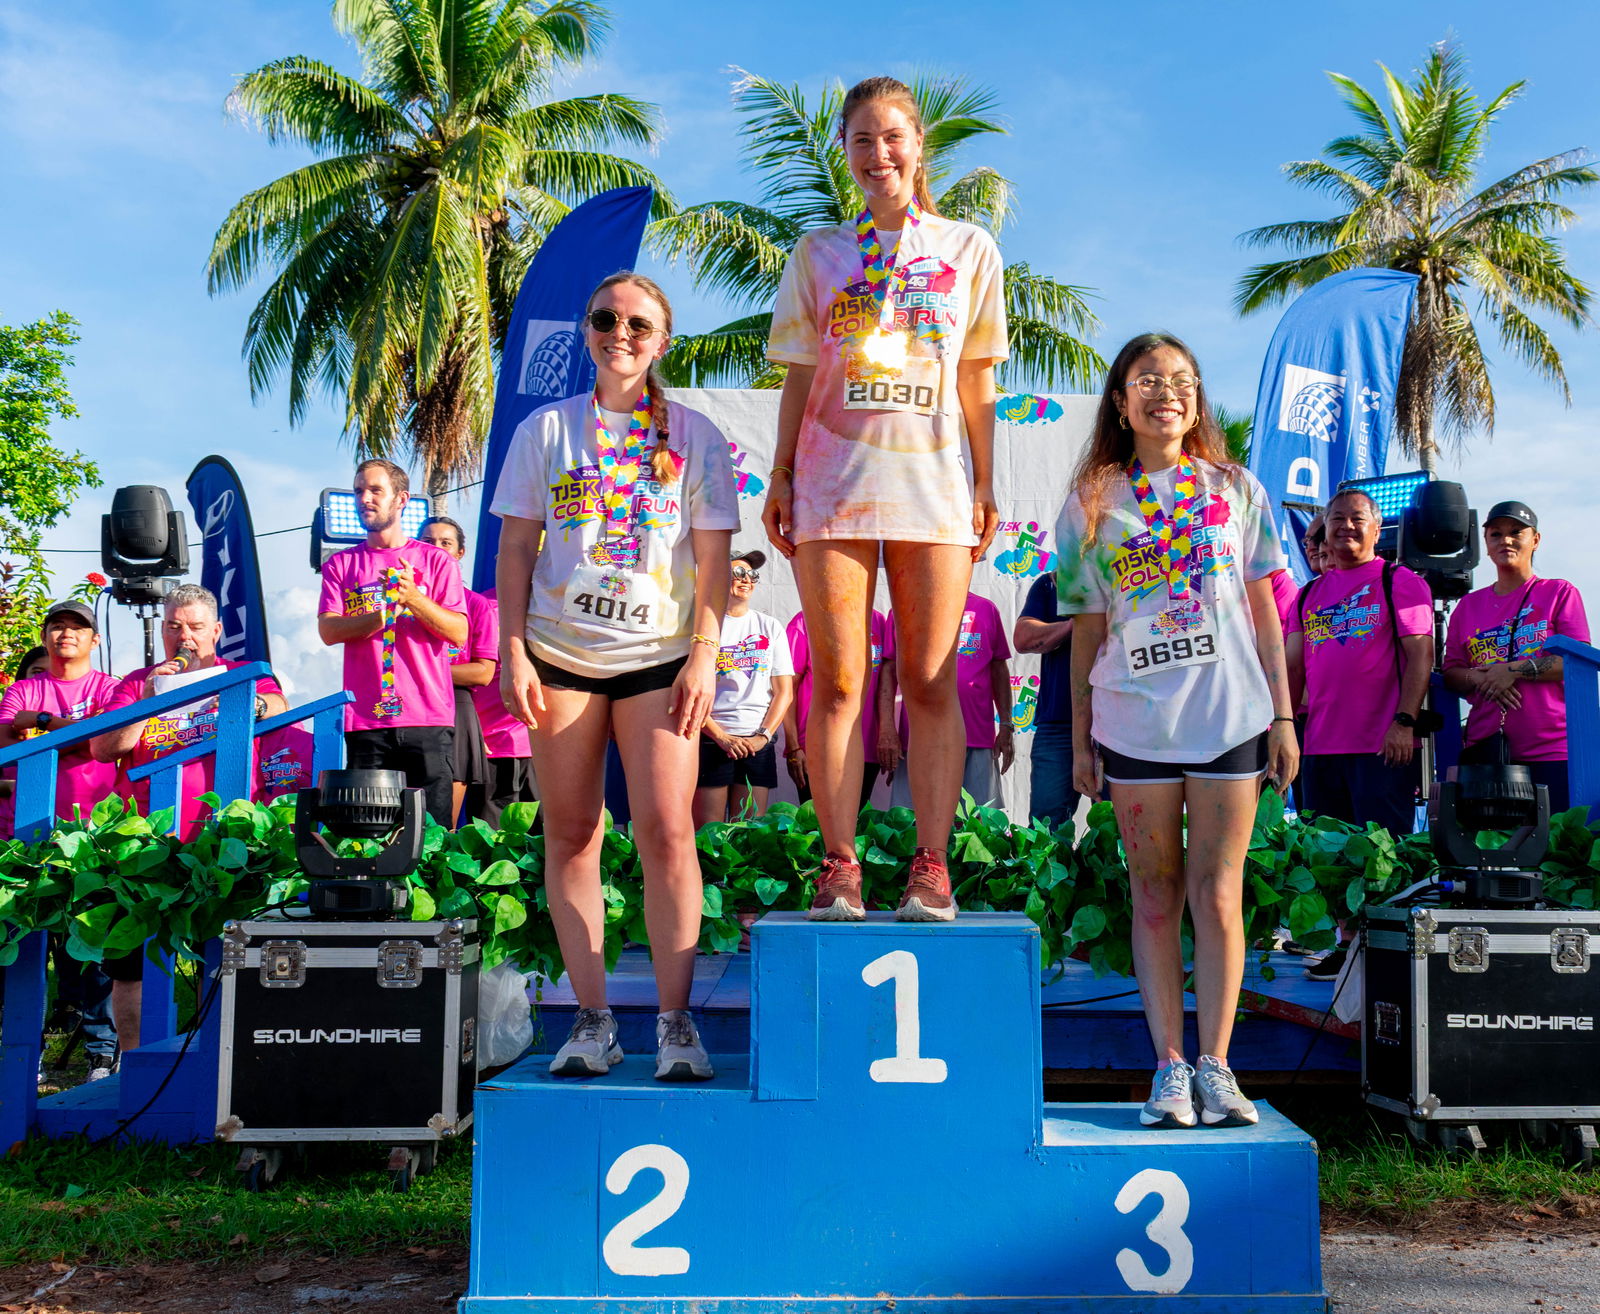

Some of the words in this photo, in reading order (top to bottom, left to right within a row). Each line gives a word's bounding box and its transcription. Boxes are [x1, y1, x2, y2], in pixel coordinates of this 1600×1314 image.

[858, 285, 870, 293] 20
[895, 292, 959, 308] UBBLE
[830, 309, 909, 338] COLR
[914, 309, 957, 327] RUN
[848, 381, 933, 408] 2030
[1354, 421, 1371, 480] EMBER
[582, 469, 600, 477] 202
[551, 479, 601, 502] TJ5K
[553, 499, 609, 520] COLO
[636, 497, 680, 515] RUN
[1136, 535, 1153, 545] 202
[1111, 546, 1158, 577] TJ5K
[1197, 541, 1237, 563] RUN
[345, 592, 374, 610] TJ5K
[349, 603, 383, 616] COLO
[573, 592, 650, 625] 4014
[1305, 615, 1332, 631] TJ5K
[1331, 604, 1380, 626] BUBBLE
[1306, 621, 1347, 642] COLOR
[1347, 615, 1380, 629] RUN
[718, 653, 733, 661] 5K
[1130, 634, 1215, 670] 3693
[1468, 637, 1498, 656] TJ5K
[1474, 645, 1509, 666] COLO
[1516, 630, 1548, 649] RUN
[716, 657, 750, 669] OLOR
[144, 720, 178, 734] TJ5K
[178, 712, 218, 730] BUBB
[144, 727, 198, 745] COLOR
[199, 722, 218, 735] RU
[861, 950, 948, 1083] 1
[1447, 1014, 1594, 1031] SOUNDHIRE
[253, 1028, 421, 1044] SOUNDHIRE
[603, 1143, 690, 1276] 2
[1114, 1168, 1194, 1294] 3
